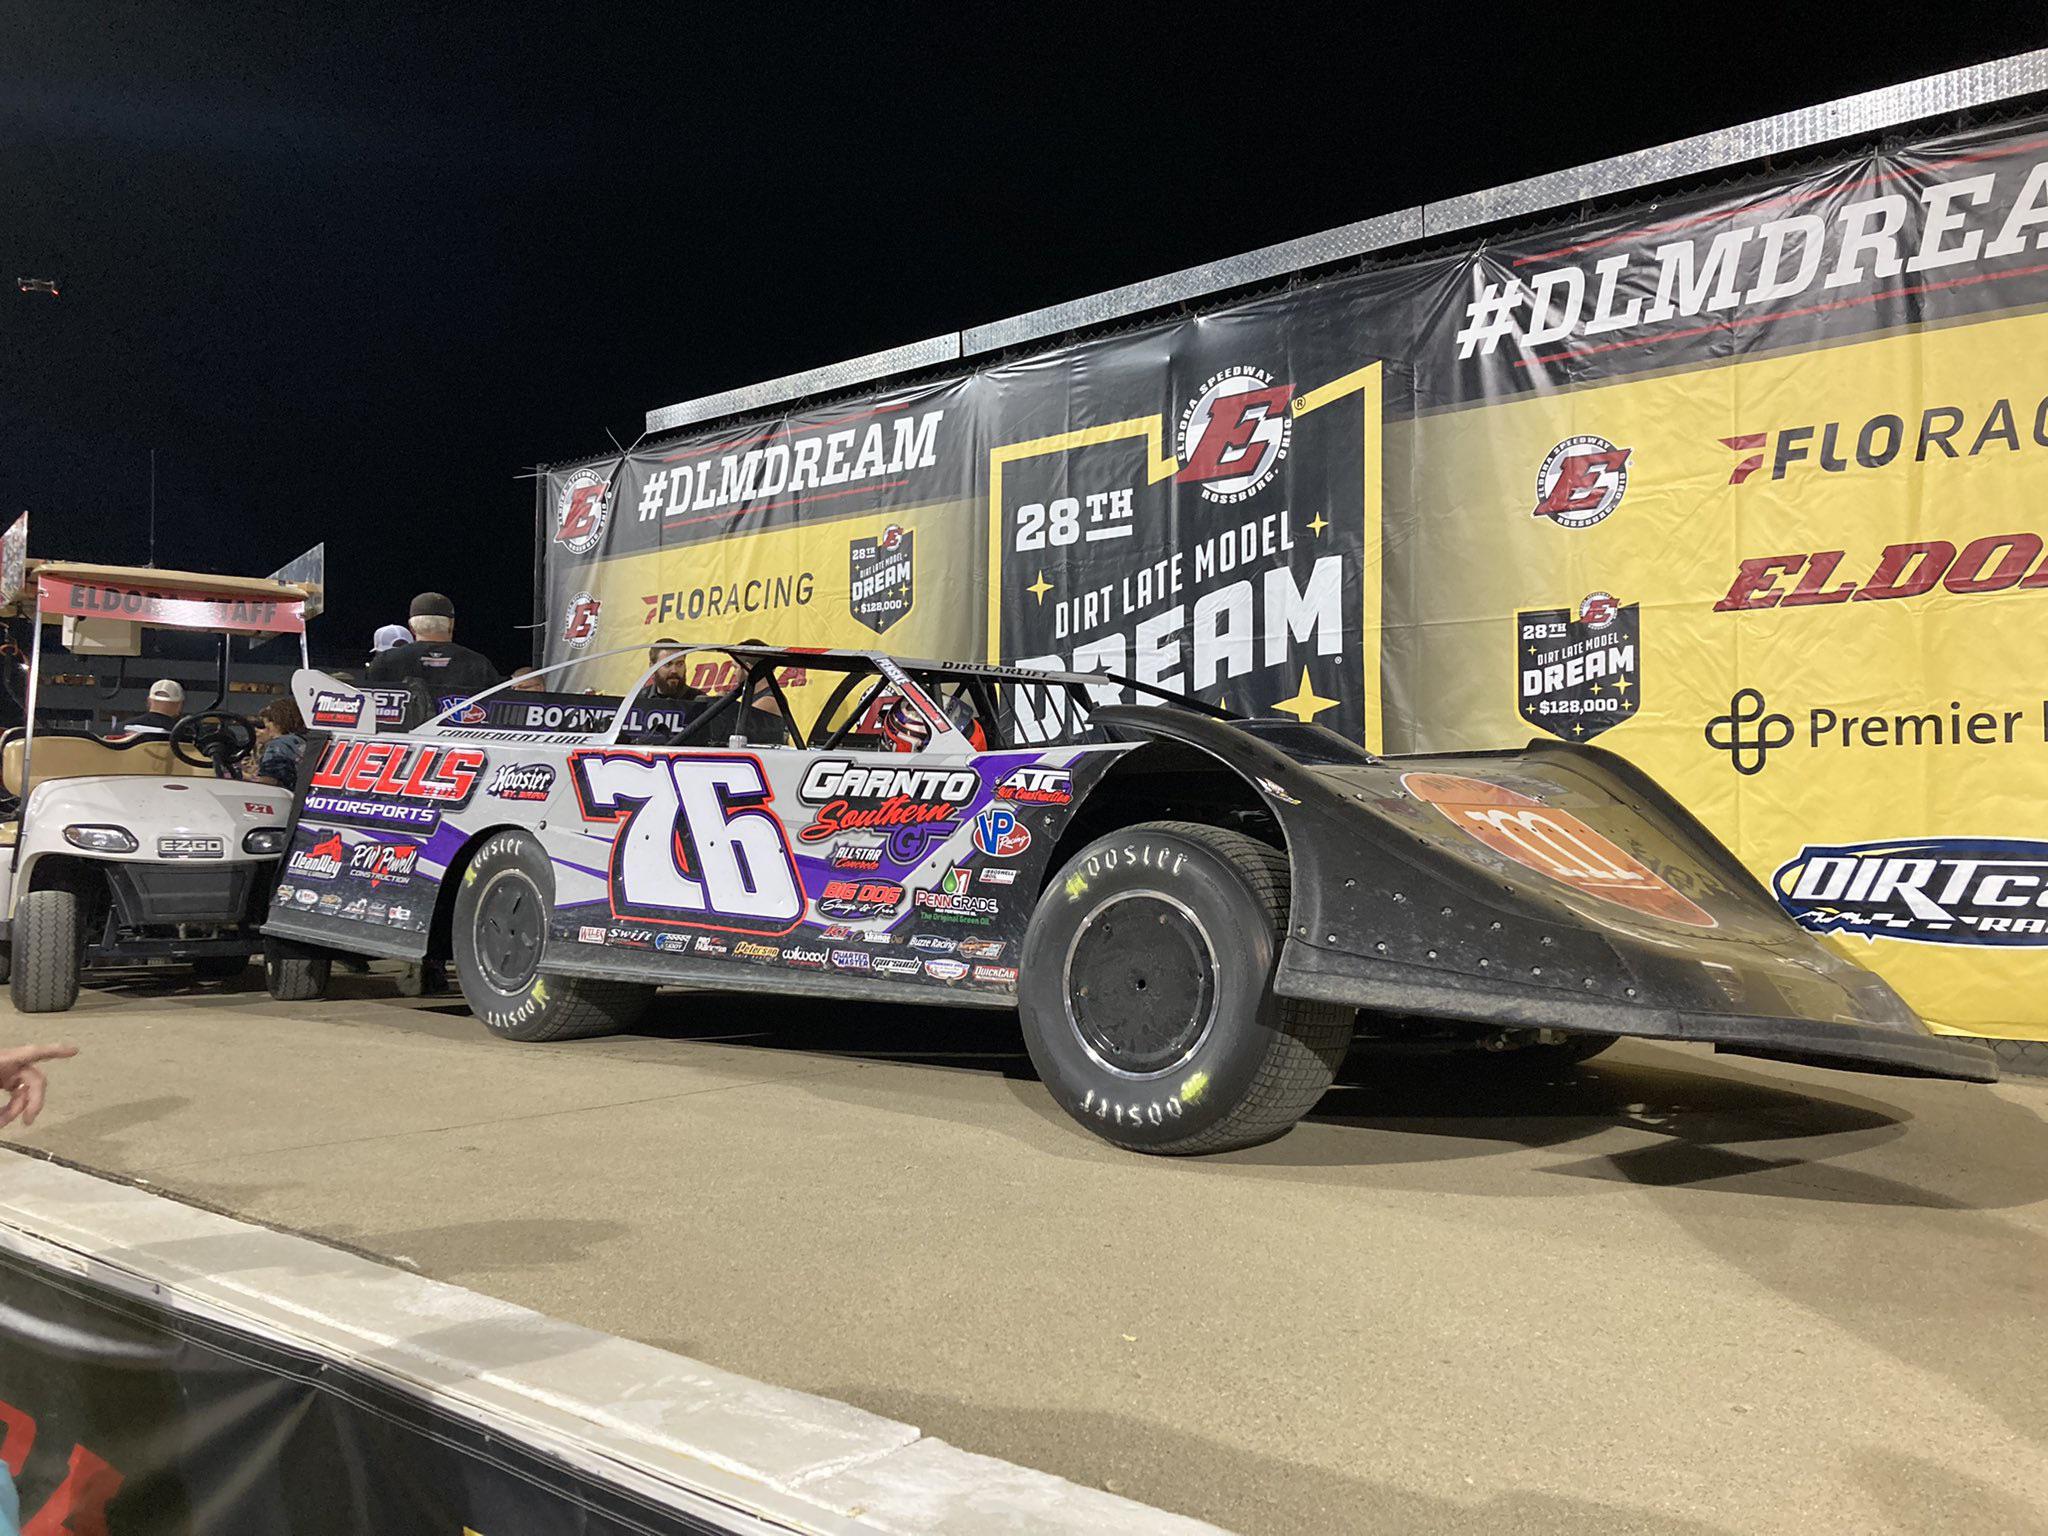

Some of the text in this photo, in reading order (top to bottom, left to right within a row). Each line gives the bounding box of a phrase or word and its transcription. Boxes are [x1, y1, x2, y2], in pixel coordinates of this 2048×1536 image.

[1199, 365, 1275, 395] SPEEDWAY
[1278, 419, 1293, 460] OHIO
[1553, 436, 1611, 455] SPEEDWAY
[639, 410, 944, 522] #DLMDREAM
[1015, 487, 1134, 552] 28TH
[852, 561, 911, 602] DREAM
[1055, 510, 1295, 639] DIRT LATE MODEL
[658, 571, 815, 624] FLORACING
[860, 600, 902, 614] $128,000
[1522, 623, 1567, 640] 28TH
[1013, 554, 1343, 745] DREAM
[1537, 632, 1619, 666] DIRT LATE MODEL
[1522, 644, 1635, 697] DREAM
[317, 695, 360, 713] Midwest
[1539, 698, 1619, 715] $128,000
[437, 729, 594, 745] CONVENIENT LUBE
[1810, 701, 2023, 748] Premier
[311, 739, 485, 801] WELLS
[489, 765, 551, 792] Hoosier
[800, 759, 976, 802] GARNTO
[1000, 768, 1071, 794] ATC
[305, 795, 436, 822] MOTORSPORTS
[800, 794, 955, 840] Southern
[577, 753, 804, 924] 76
[975, 810, 1016, 856] VP
[289, 850, 342, 879] CleanWay
[378, 847, 418, 874] Powell
[836, 846, 883, 861] ALLSTAR
[350, 869, 410, 884] CONSTRUCTION
[1791, 857, 2048, 921] DIRTc
[822, 881, 904, 904] BIG DOG
[915, 889, 999, 914] PENNGRADE
[607, 928, 652, 941] Swift
[1977, 917, 2048, 933] RA
[735, 941, 780, 956] Peterson
[782, 945, 830, 965] wilwood
[832, 950, 868, 961] QUARTER
[931, 938, 957, 951] Racing
[838, 958, 869, 967] MASTER
